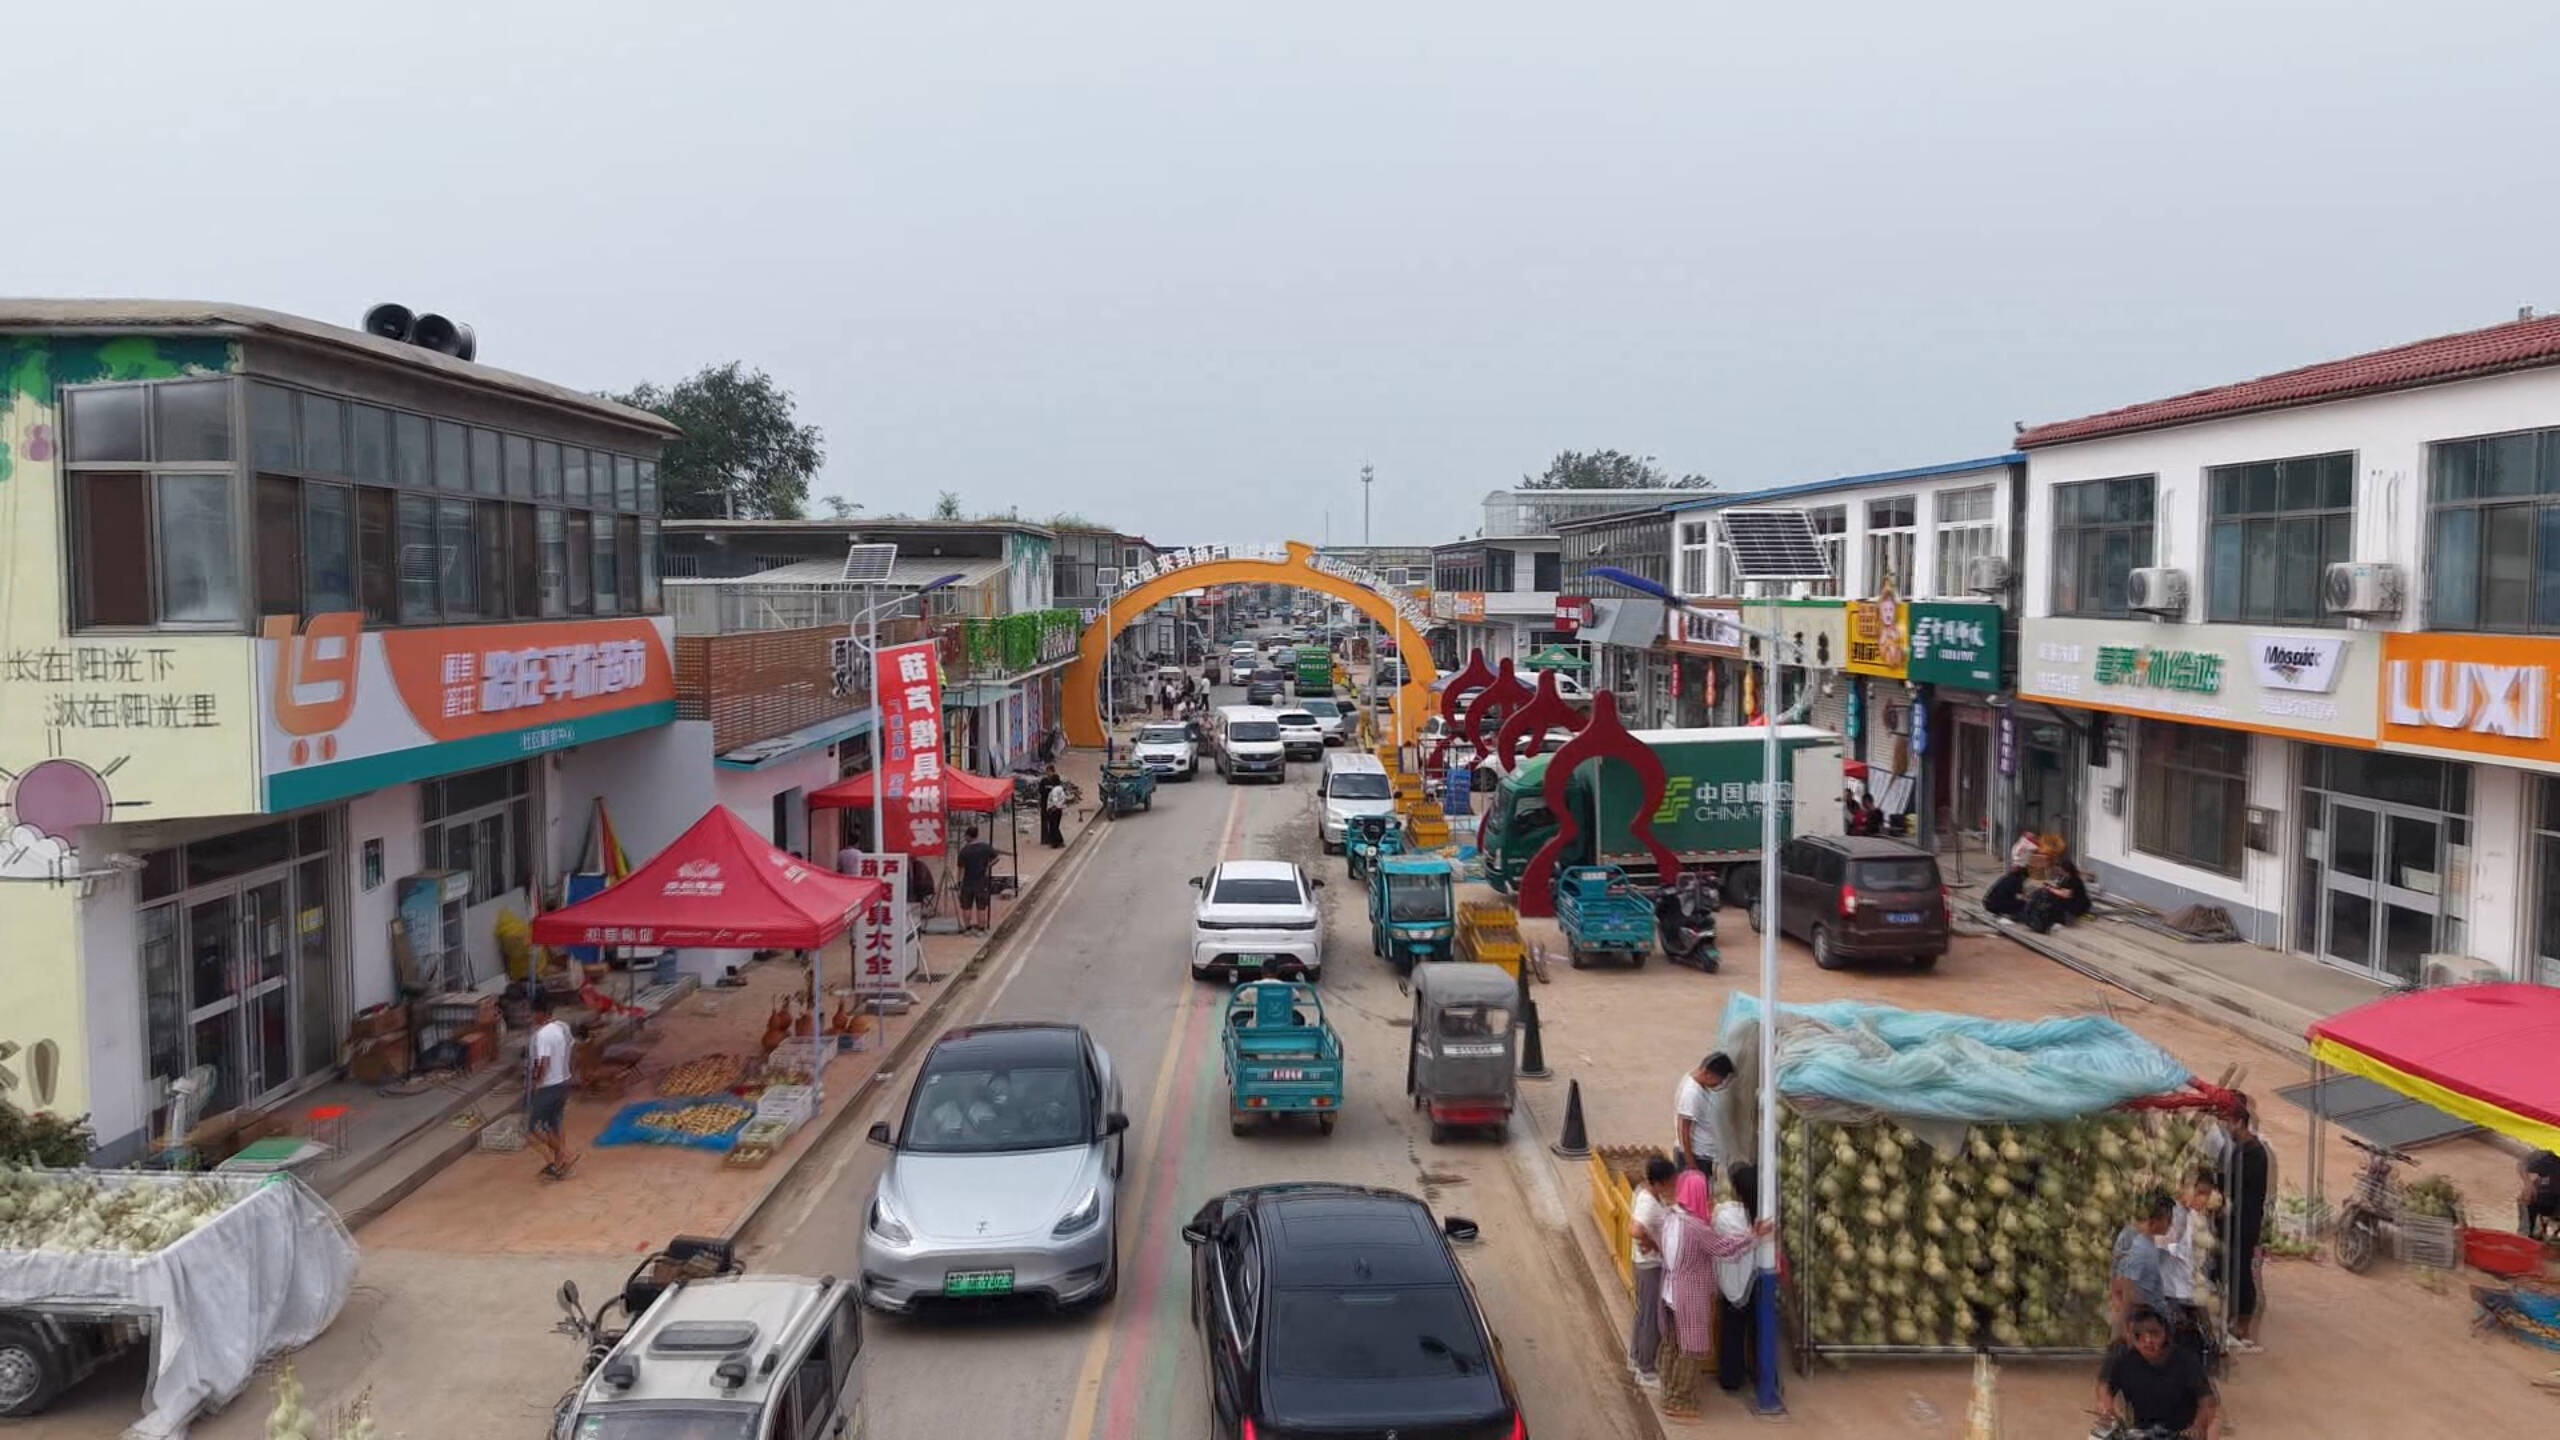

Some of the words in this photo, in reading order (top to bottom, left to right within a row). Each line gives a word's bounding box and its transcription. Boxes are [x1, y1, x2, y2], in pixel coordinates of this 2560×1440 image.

[0, 647, 176, 682] 长在阳光下
[2385, 659, 2548, 740] LUXI
[1694, 806, 1749, 822] CHINA
